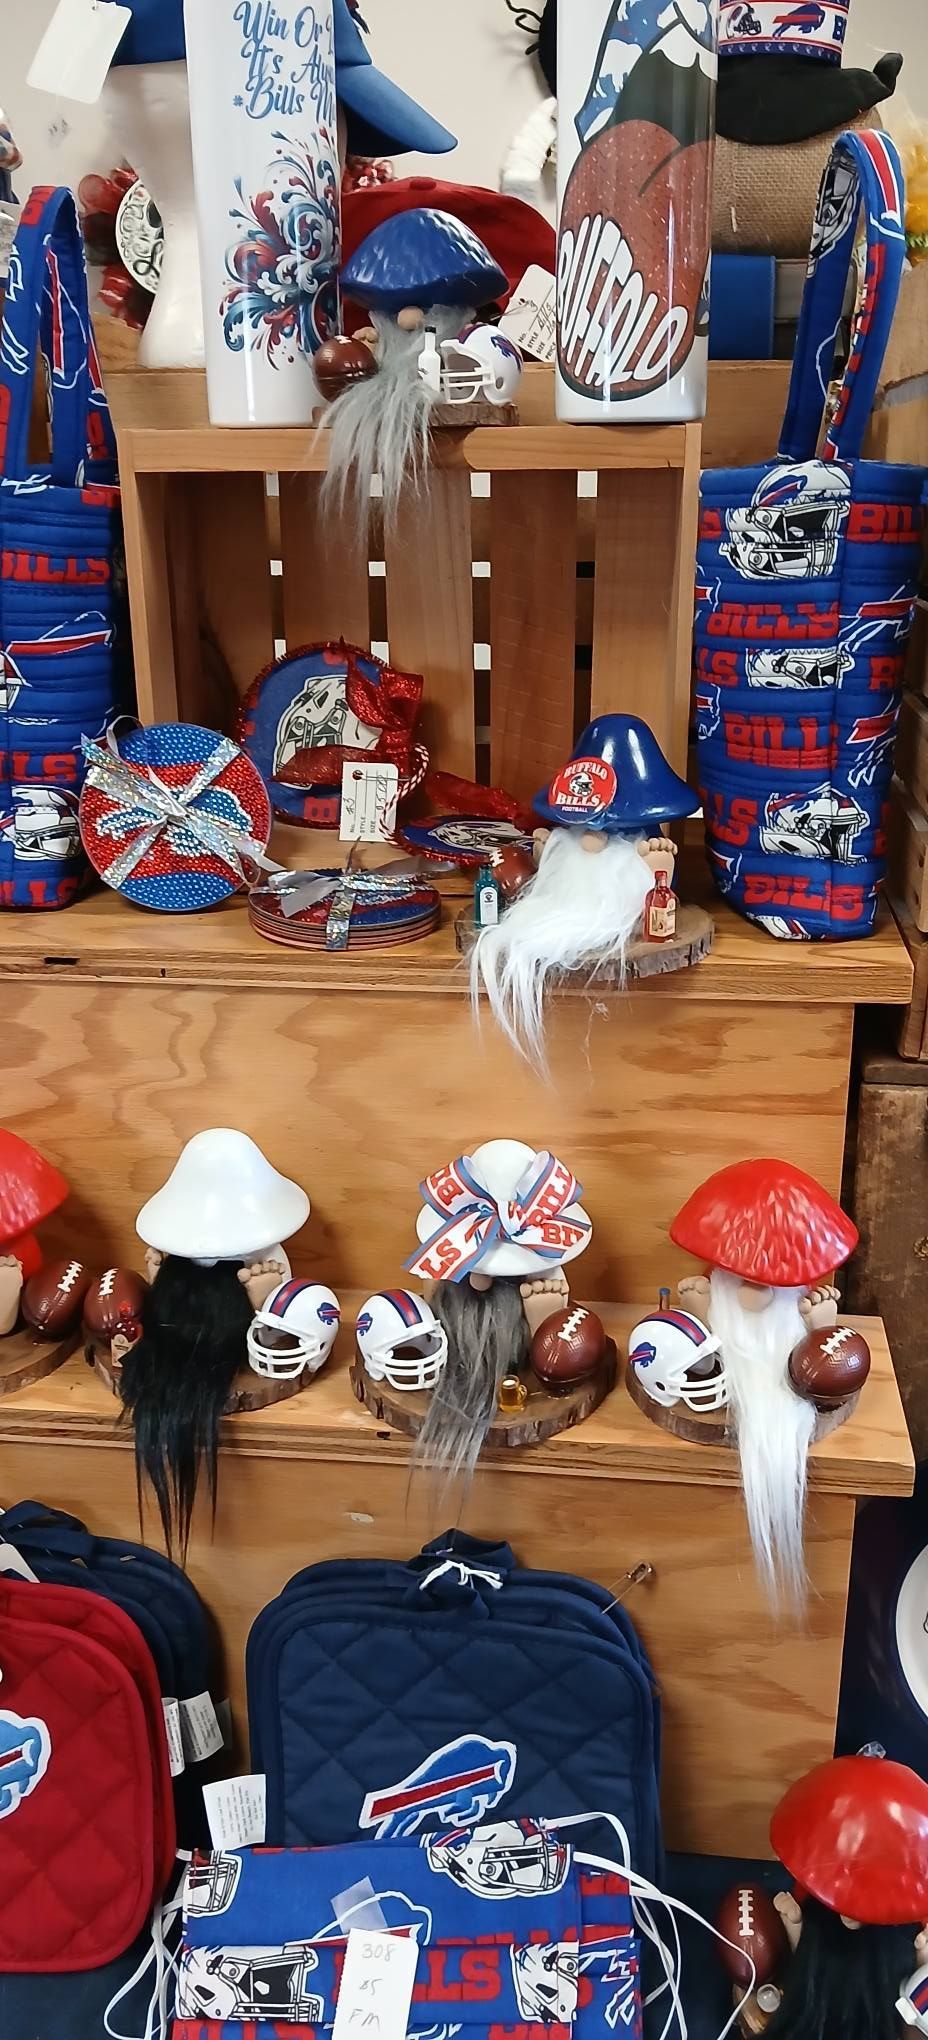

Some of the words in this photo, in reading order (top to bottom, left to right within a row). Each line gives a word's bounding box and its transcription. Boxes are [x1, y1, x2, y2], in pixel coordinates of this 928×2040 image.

[233, 0, 289, 42] Win
[294, 6, 323, 48] Or
[557, 214, 689, 387] BUFFALO
[563, 761, 608, 780] BUFFALO
[555, 791, 602, 807] BILLS
[561, 805, 588, 813] FOOTBALL
